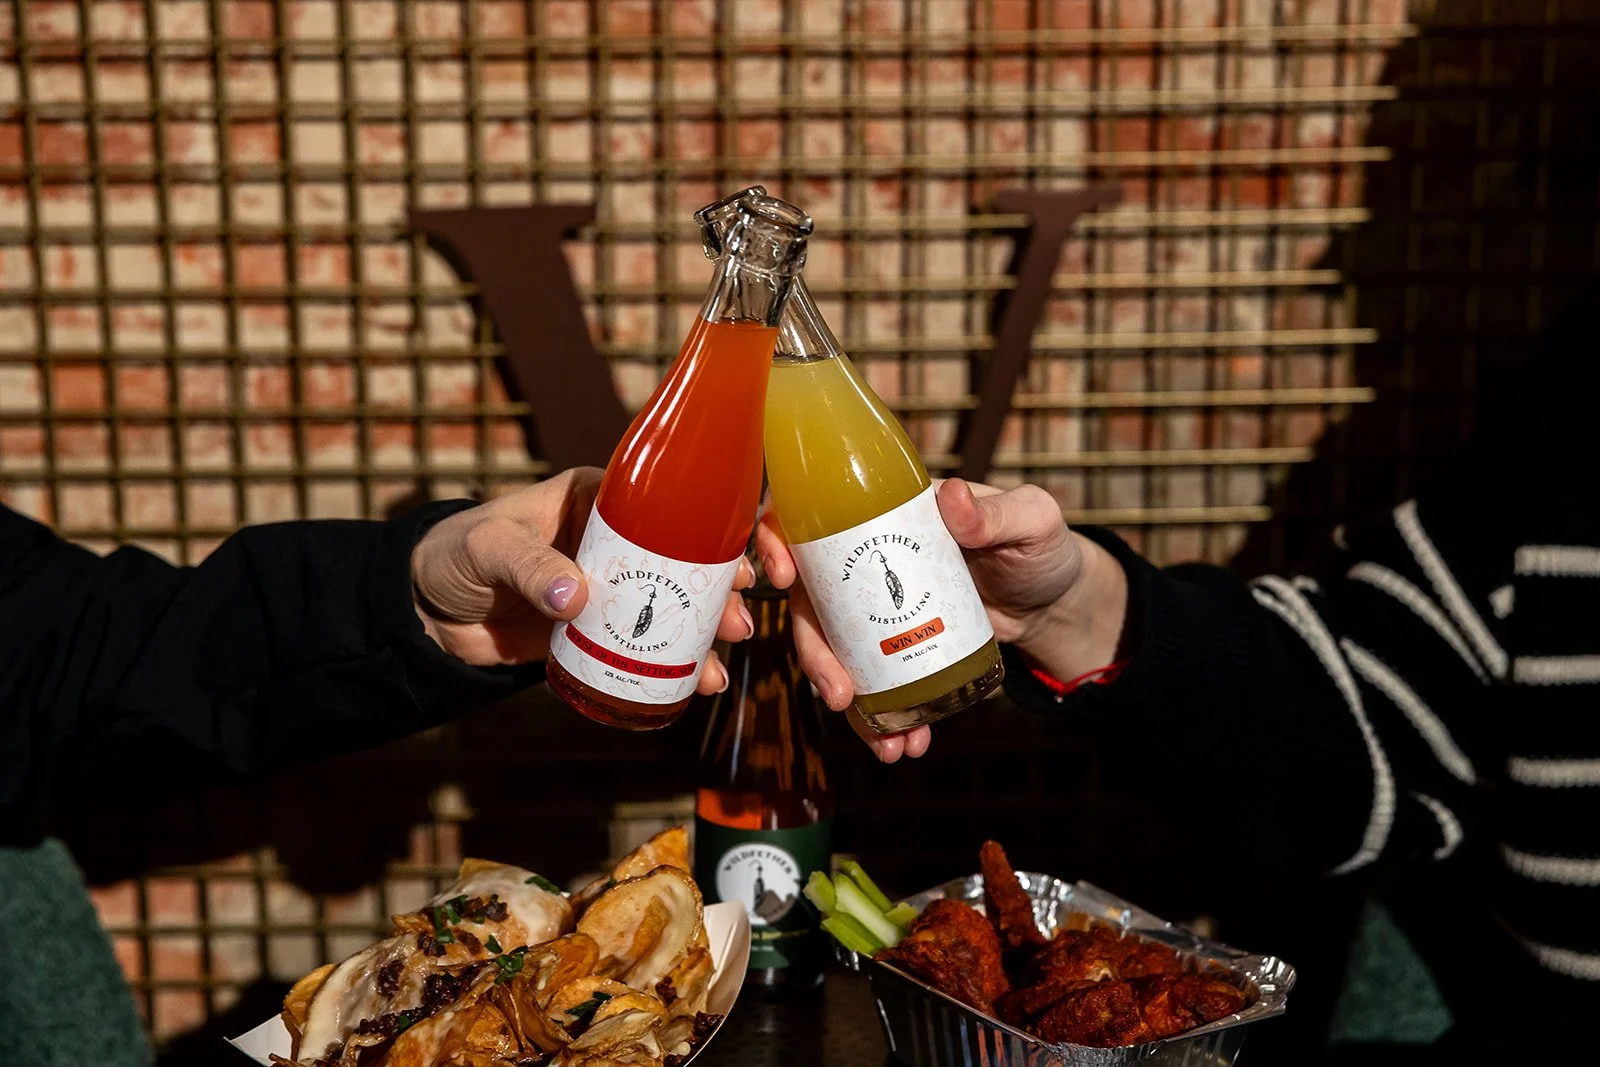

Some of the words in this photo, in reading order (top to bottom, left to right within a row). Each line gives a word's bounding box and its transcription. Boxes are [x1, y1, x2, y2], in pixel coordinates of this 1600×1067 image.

[841, 534, 921, 582] WILDFETHER
[608, 570, 691, 610] WILDFETHER
[868, 591, 931, 624] DISTILLING
[604, 622, 668, 652] DISTILLING
[889, 635, 913, 651] WIN
[914, 624, 937, 641] WIN
[595, 649, 609, 660] OF
[612, 657, 630, 670] THE
[633, 663, 676, 677] SETTING
